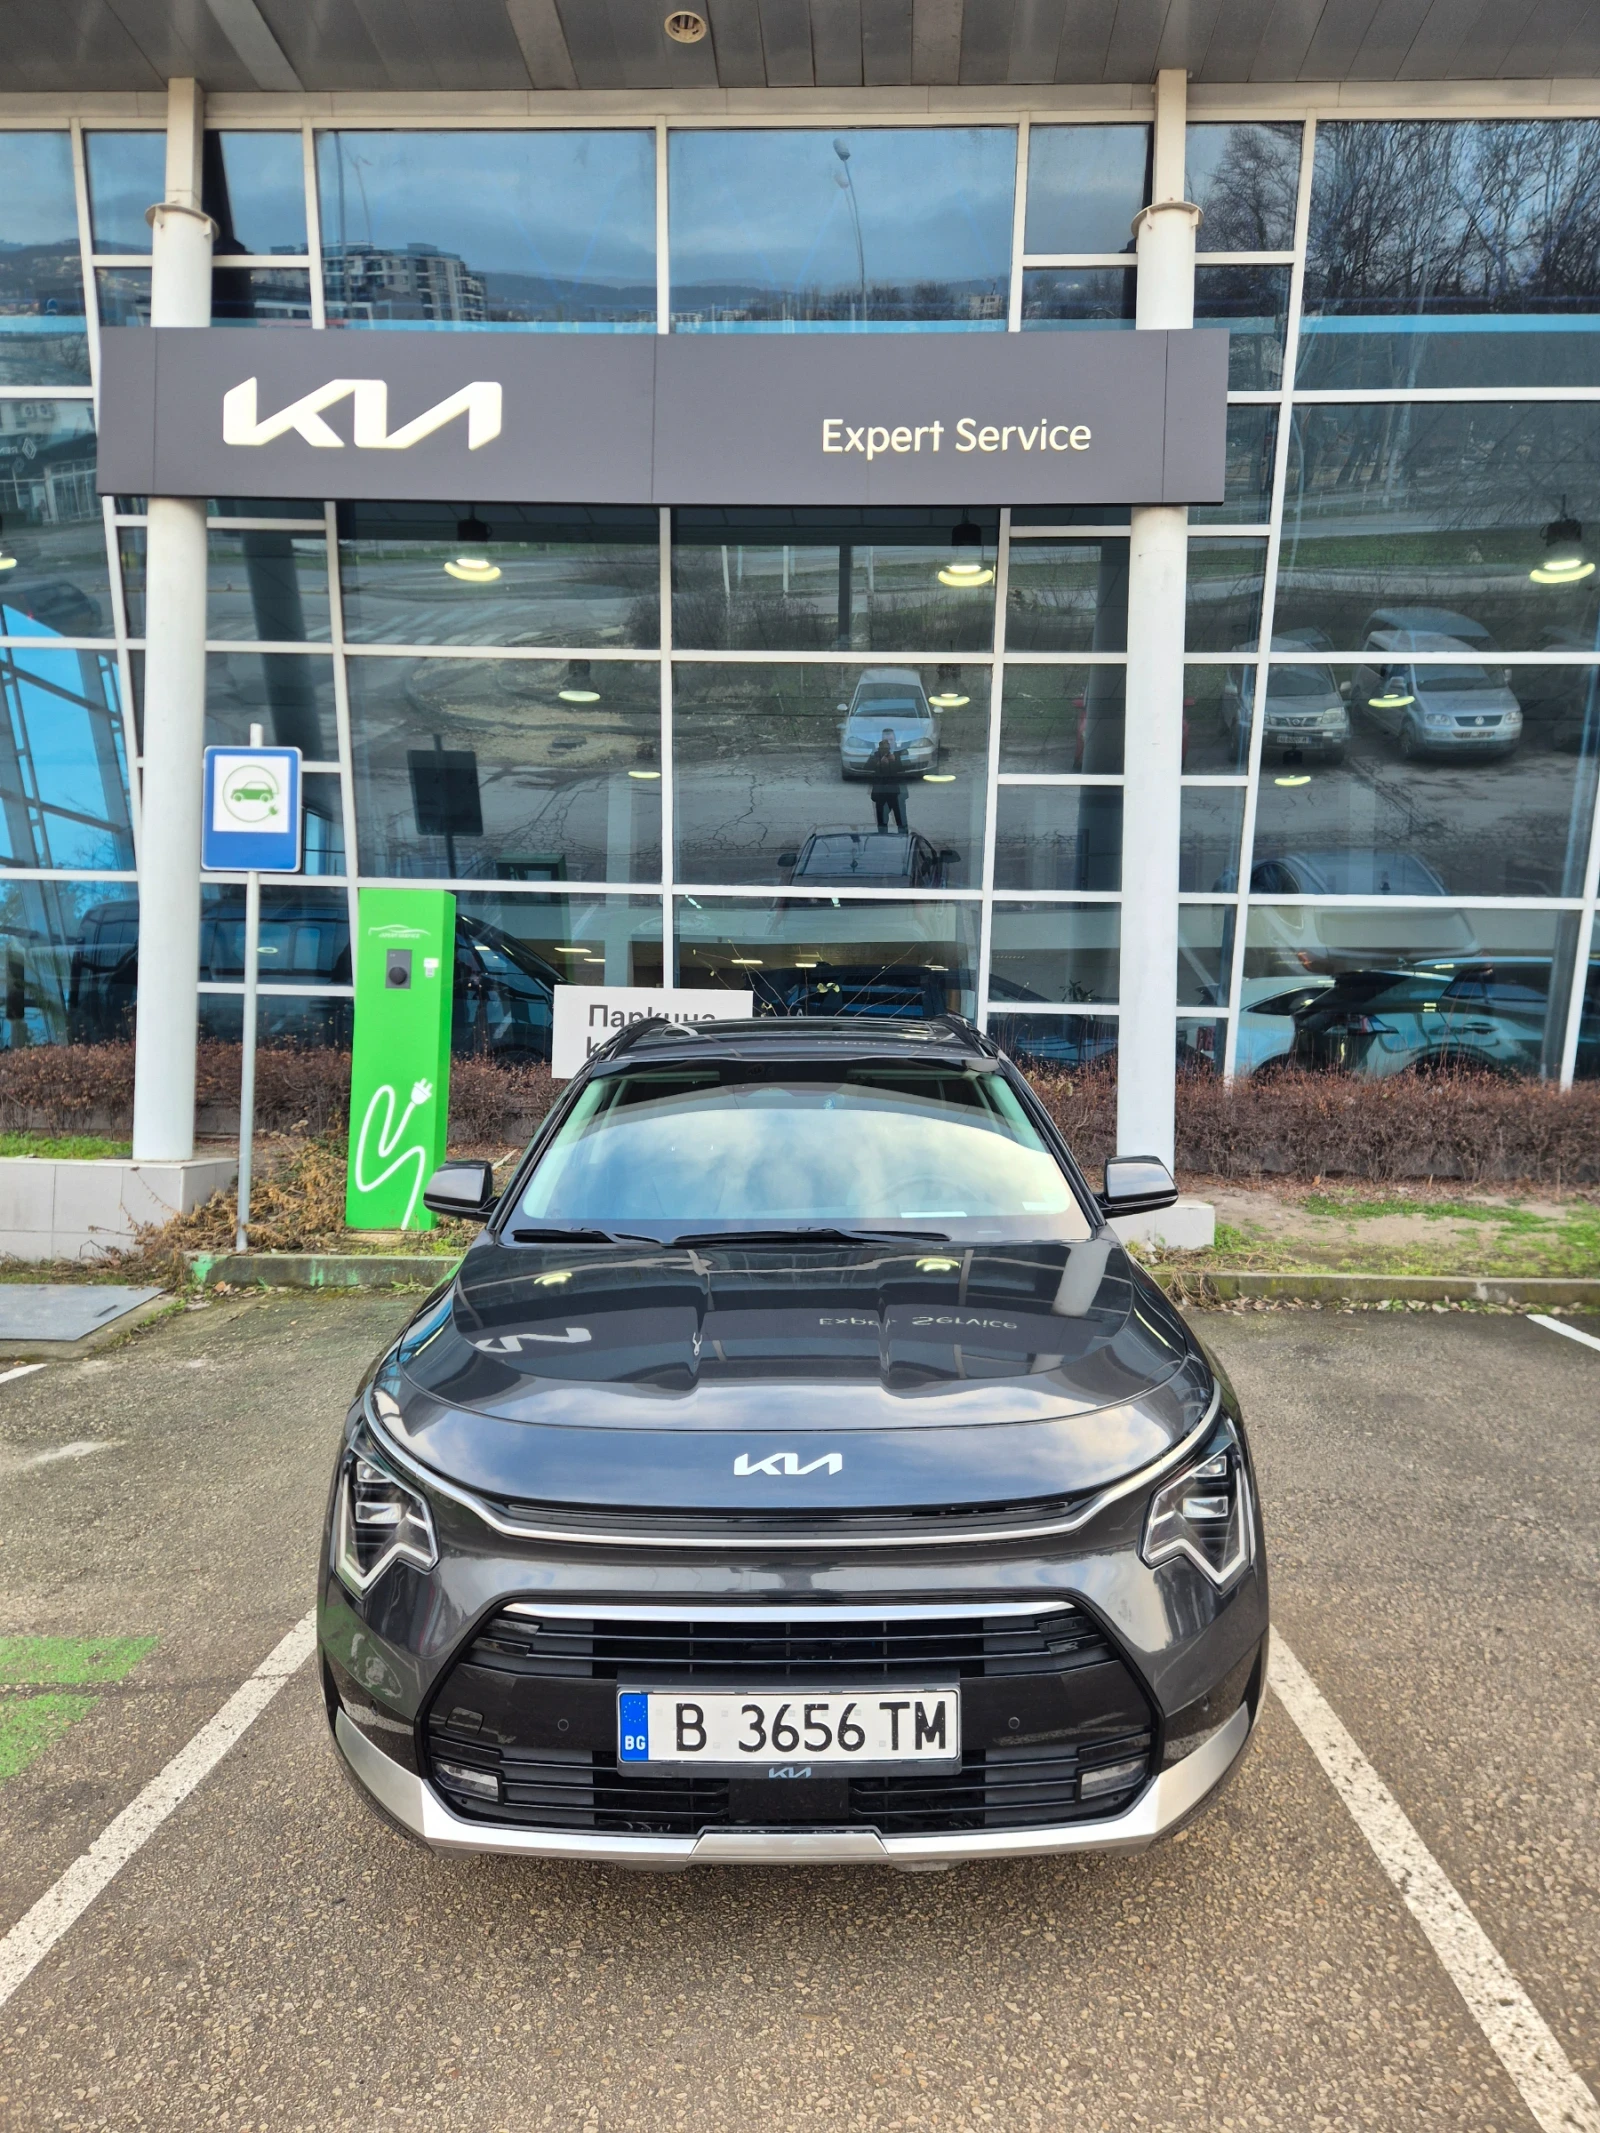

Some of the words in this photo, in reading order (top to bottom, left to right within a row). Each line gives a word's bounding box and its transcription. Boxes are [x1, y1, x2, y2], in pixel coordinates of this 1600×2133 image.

[223, 376, 503, 451] KIA
[822, 418, 945, 461] Expert
[955, 417, 1092, 452] Service
[588, 1003, 717, 1029] Паркин
[733, 1452, 843, 1476] KIA
[675, 1702, 708, 1752] B
[738, 1702, 866, 1753] 3656
[879, 1700, 947, 1751] TM
[624, 1735, 647, 1751] BG
[768, 1766, 812, 1779] KIA
